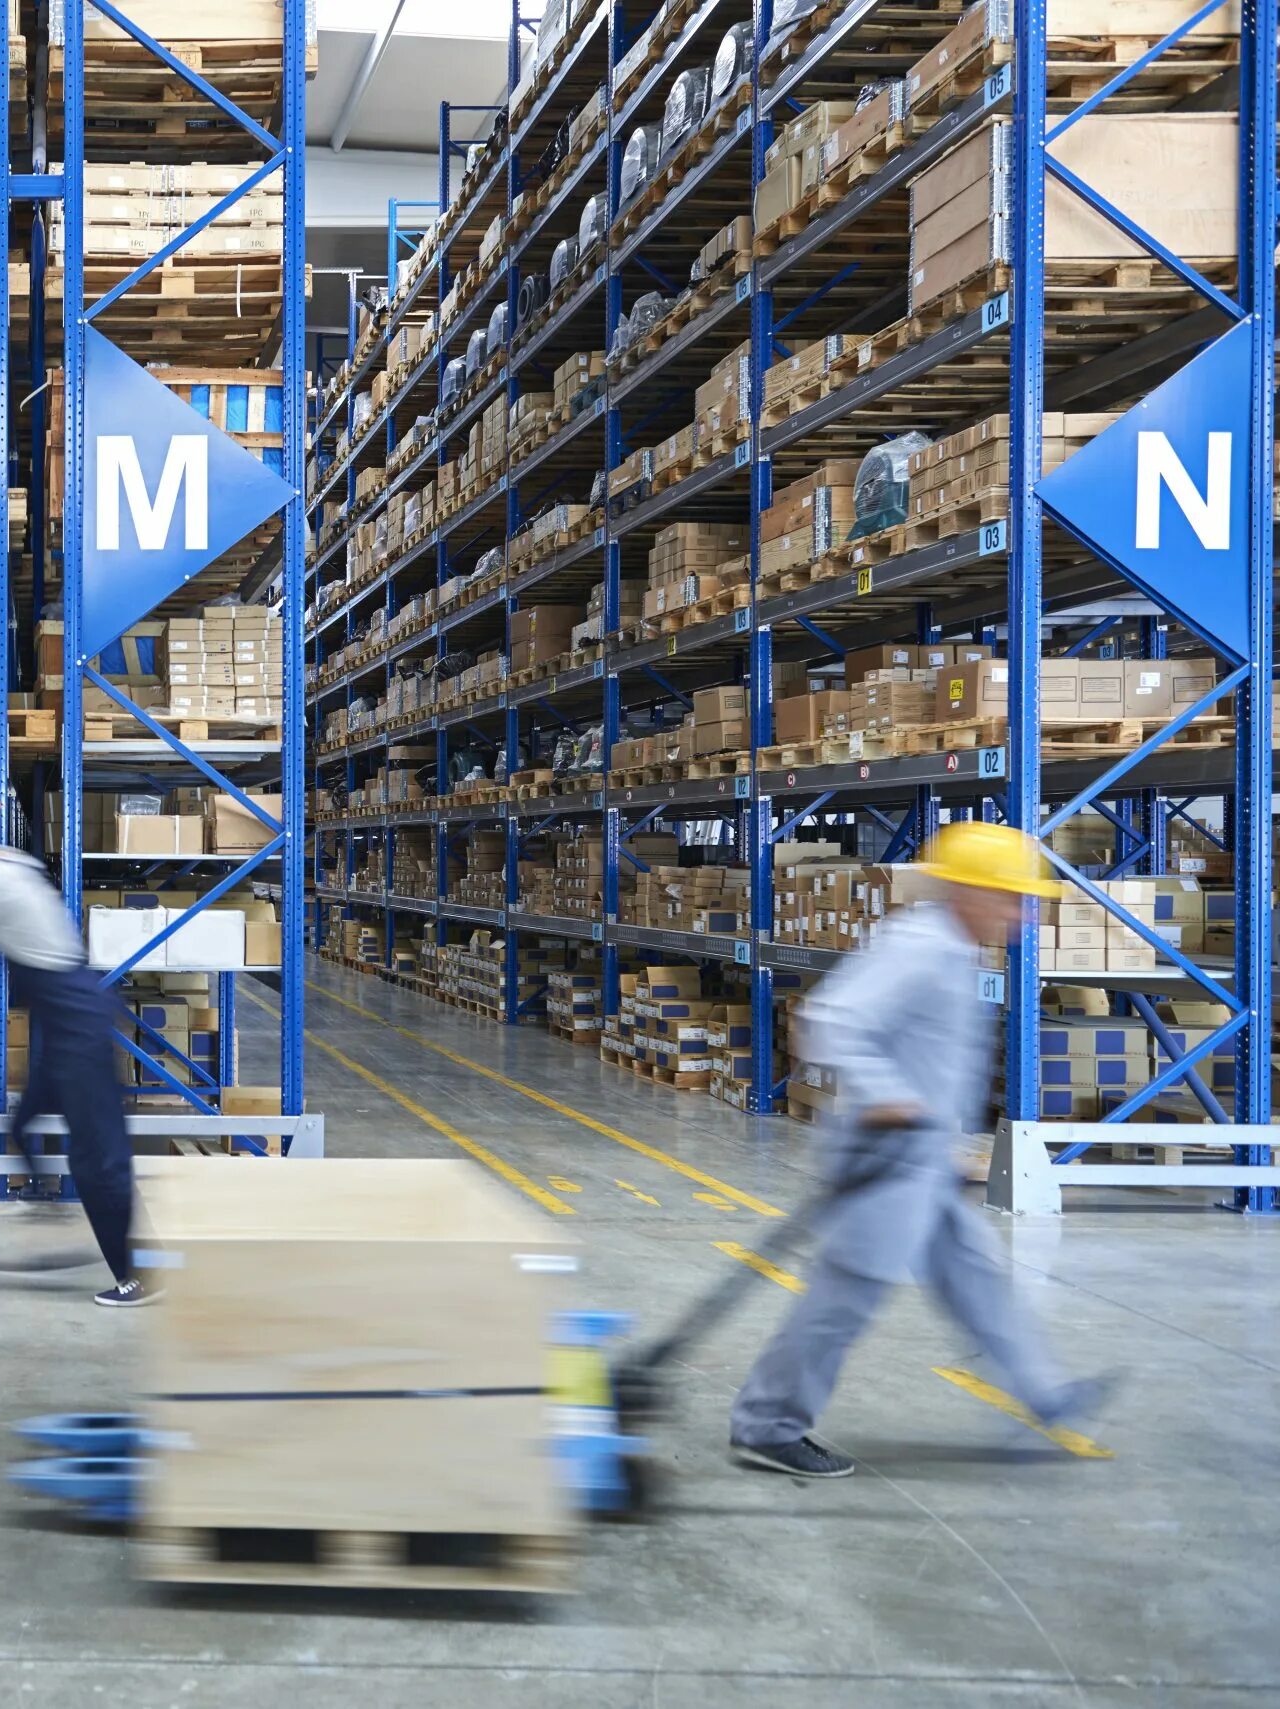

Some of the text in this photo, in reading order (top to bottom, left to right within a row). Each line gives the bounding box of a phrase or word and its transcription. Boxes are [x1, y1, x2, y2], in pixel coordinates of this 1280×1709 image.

[990, 72, 1004, 100] 05
[739, 278, 747, 298] 05
[987, 299, 1001, 325] 04
[738, 444, 746, 463] 04
[96, 434, 209, 551] M
[1135, 431, 1233, 551] N
[985, 526, 999, 550] 03
[860, 570, 869, 591] 01
[738, 611, 746, 629] 03
[1102, 646, 1111, 658] 03
[860, 766, 867, 778] B
[947, 756, 955, 769] A
[985, 751, 999, 773] 02
[738, 779, 746, 795] 02
[738, 944, 746, 961] d1
[984, 977, 996, 999] d1
